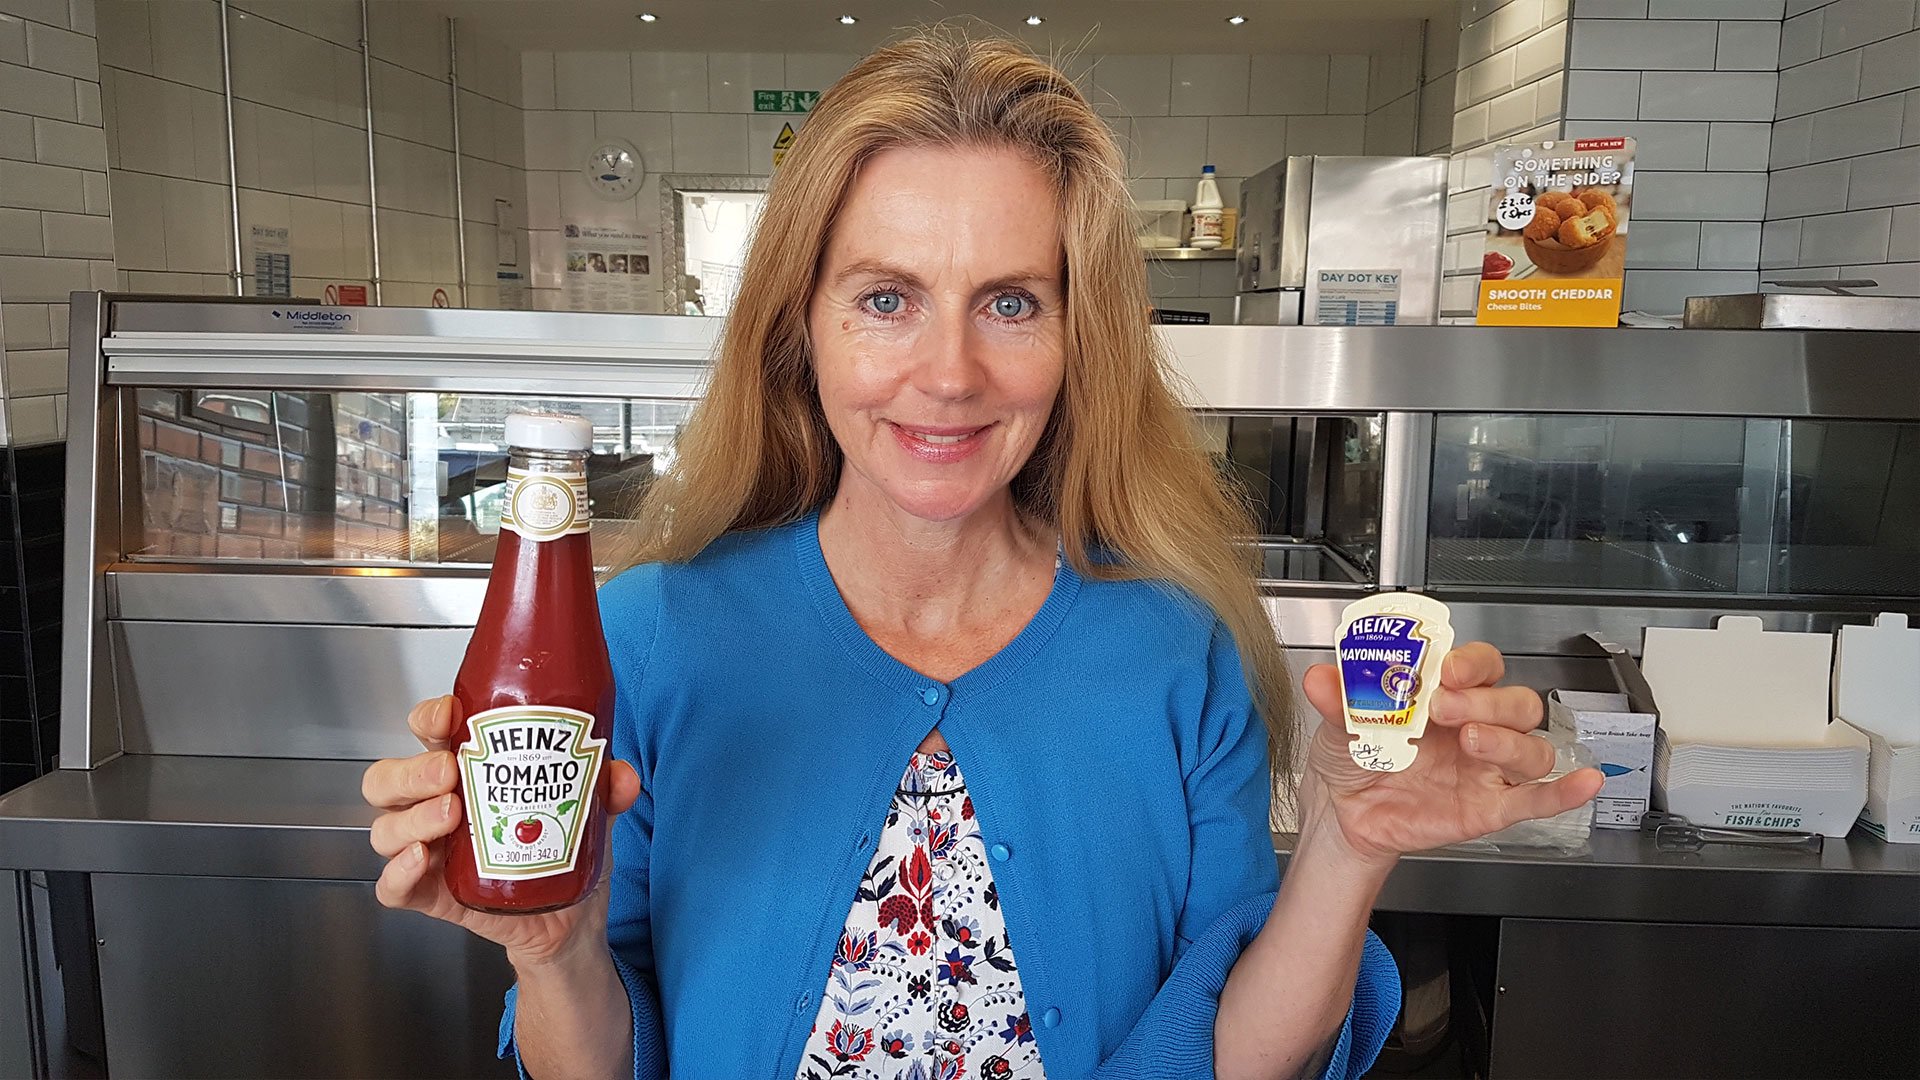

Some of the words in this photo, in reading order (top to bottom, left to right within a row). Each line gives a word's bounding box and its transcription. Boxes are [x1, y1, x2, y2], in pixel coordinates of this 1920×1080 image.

[758, 92, 776, 100] Fire
[758, 102, 775, 110] exit
[1514, 156, 1612, 172] SOMETHING
[1504, 176, 1528, 188] ON
[1535, 174, 1566, 187] THE
[1572, 172, 1622, 186] SIDE?
[1321, 273, 1344, 282] DAY
[1348, 274, 1372, 282] DOT
[1376, 274, 1398, 284] KEY
[1488, 290, 1546, 300] SMOOTH
[1551, 289, 1612, 300] CHEDDAR
[1487, 302, 1518, 310] Cheese
[1519, 302, 1542, 310] Bites
[286, 311, 351, 321] Middleton
[1352, 619, 1406, 636] HEINZ
[1341, 648, 1411, 662] MAYONNAISE
[488, 728, 572, 754] HEINZ
[518, 753, 540, 762] 1869
[482, 760, 578, 786] TOMATO
[488, 783, 573, 804] KETCHUP
[1725, 815, 1754, 826] FISH
[1763, 816, 1801, 827] CHIPS
[506, 851, 520, 862] 300
[522, 850, 532, 862] ml
[538, 848, 552, 860] 342
